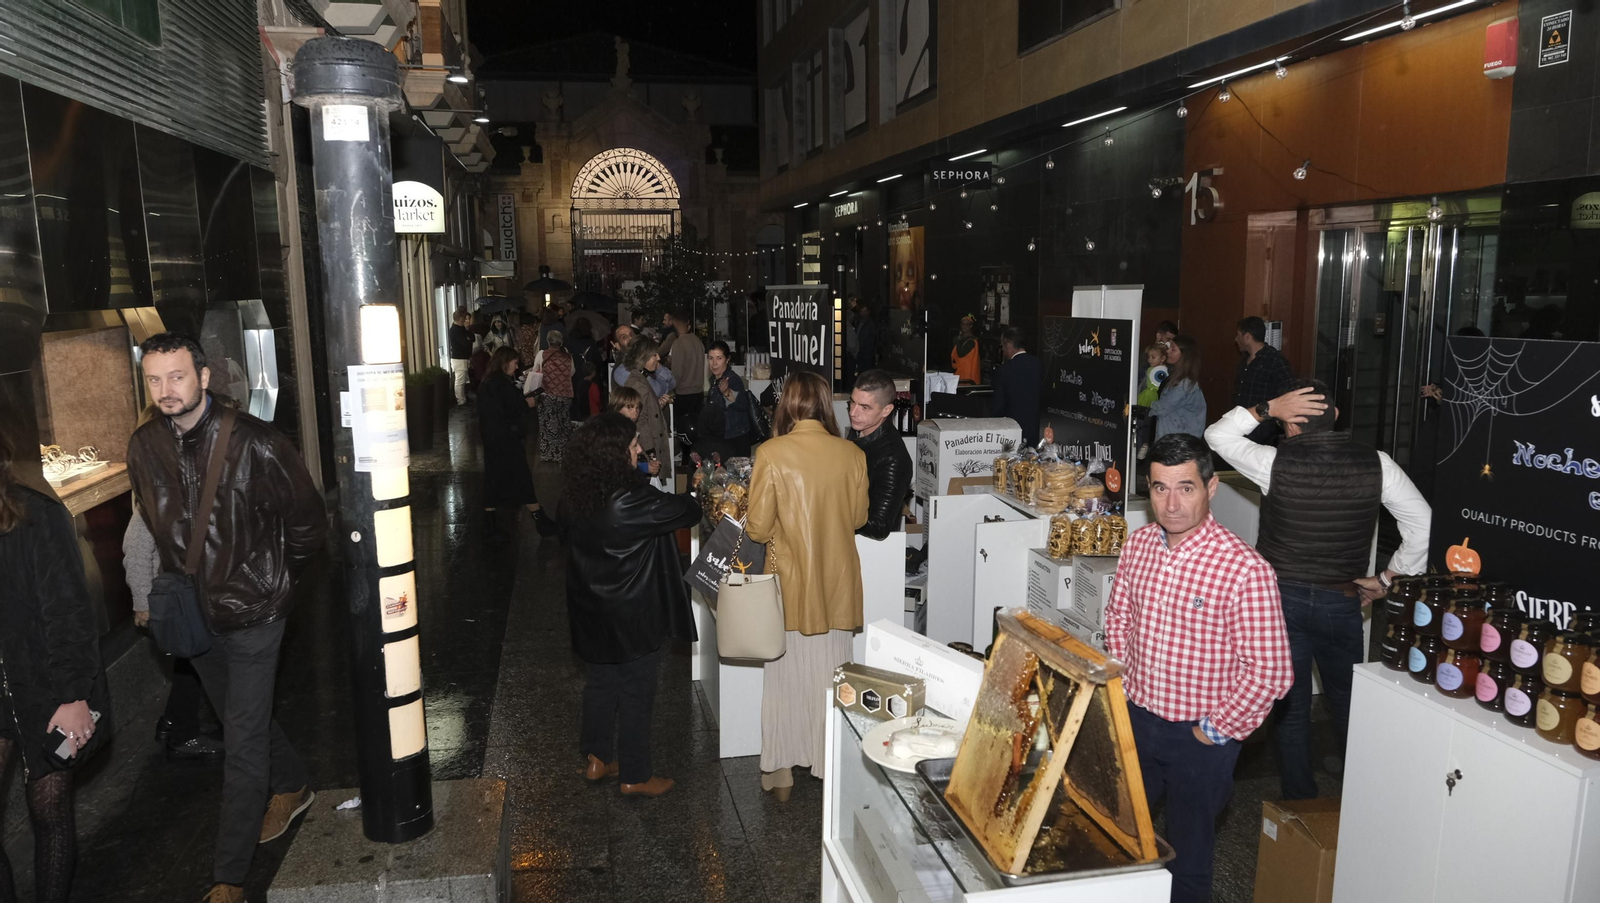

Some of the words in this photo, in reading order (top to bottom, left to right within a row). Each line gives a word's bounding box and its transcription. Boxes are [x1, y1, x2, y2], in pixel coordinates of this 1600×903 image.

[1484, 60, 1503, 69] FUEGO
[933, 170, 990, 181] SEPHORA
[394, 195, 437, 208] uizos.
[834, 200, 859, 218] SEPHORA
[1185, 167, 1224, 226] 15
[500, 204, 515, 260] swatch
[773, 295, 818, 321] Panadería
[768, 321, 783, 359] El
[785, 322, 826, 366] Túnel
[944, 432, 983, 449] Panadería
[985, 432, 994, 443] El
[1512, 439, 1600, 479] Noche
[1461, 507, 1508, 528] QUALITY
[1510, 518, 1577, 545] PRODUCTS
[1581, 535, 1600, 550] FR
